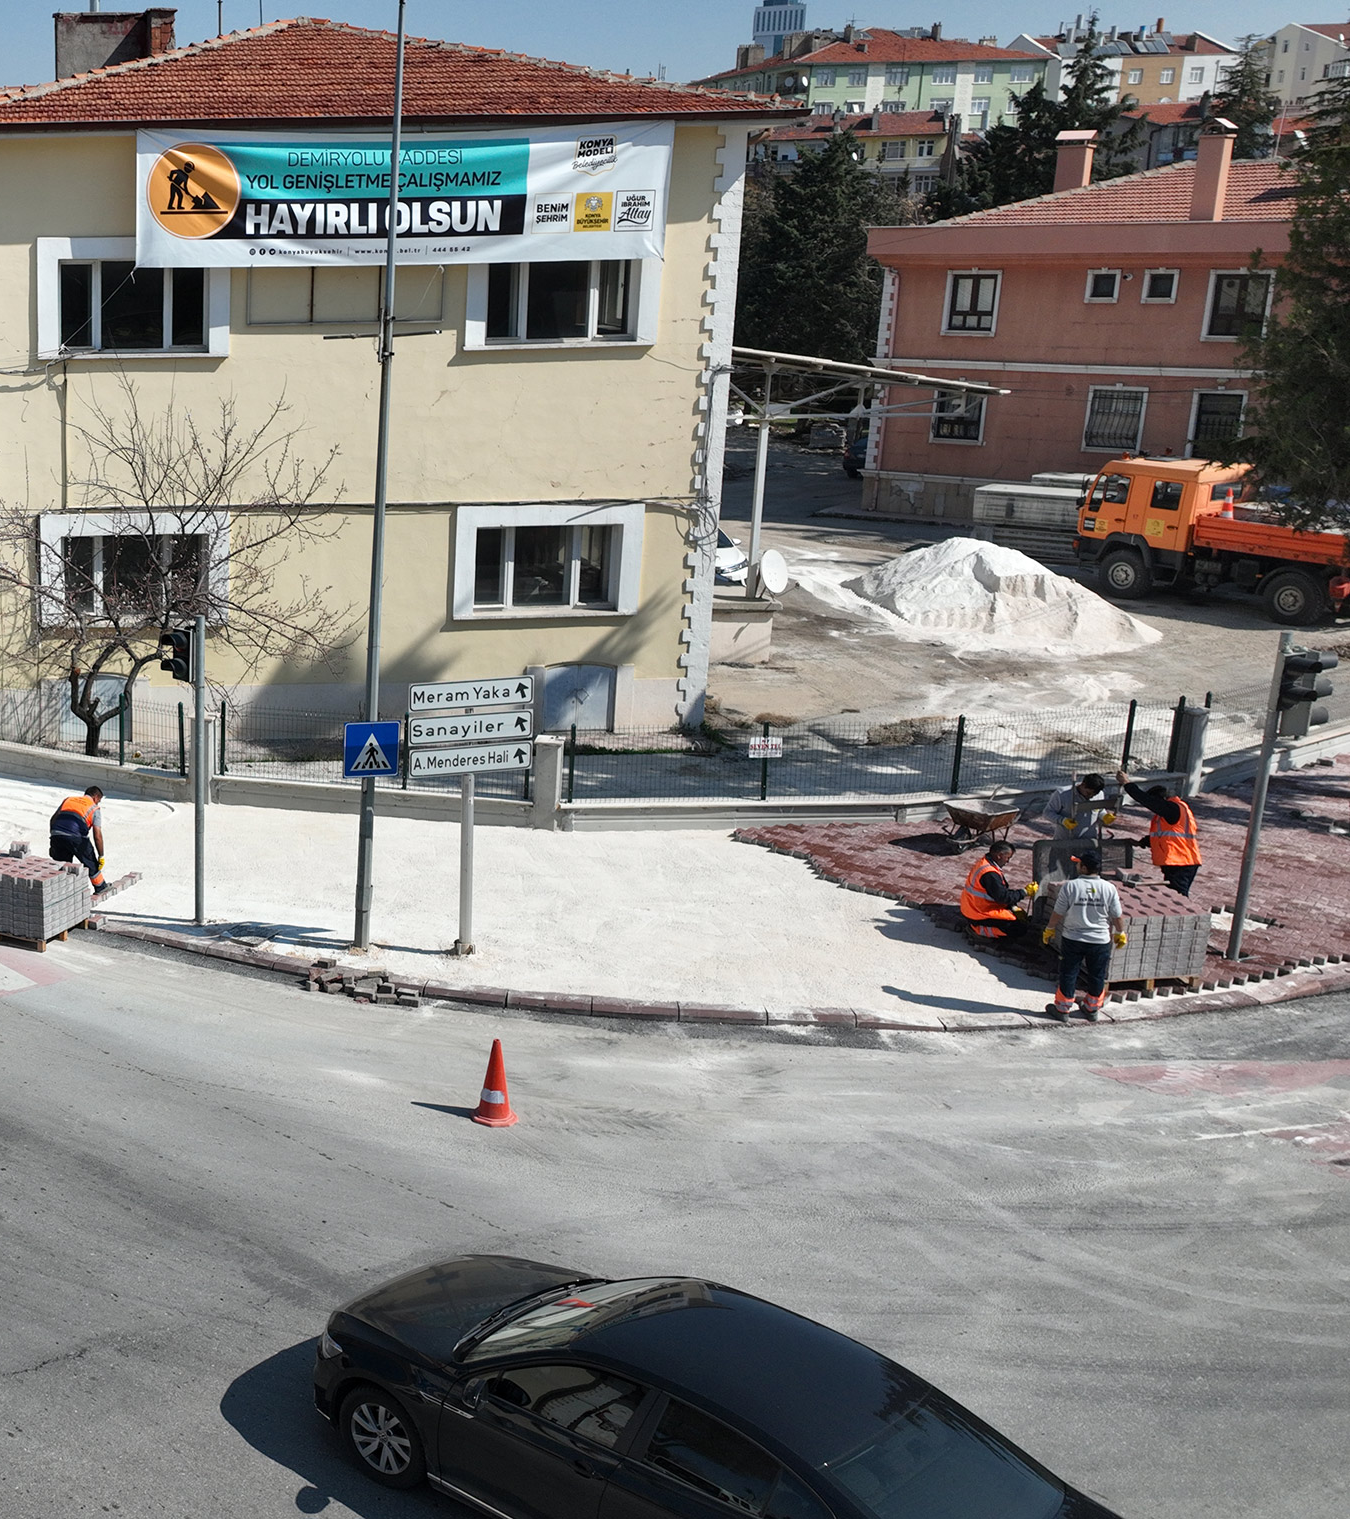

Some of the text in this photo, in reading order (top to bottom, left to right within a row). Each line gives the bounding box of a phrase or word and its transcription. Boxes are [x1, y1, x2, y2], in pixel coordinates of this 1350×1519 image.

[577, 146, 614, 158] MODELİ
[579, 138, 614, 150] KONYA
[287, 149, 385, 167] DEMİRYOLU
[246, 171, 502, 193] YOL GENİŞLETME ÇALIŞMAMIZ
[626, 194, 646, 202] UĞUR
[536, 203, 569, 213] BENİM
[617, 207, 652, 224] Altay
[245, 200, 502, 235] HAYIRLI OLSUN
[536, 213, 568, 224] ŞEHRİM
[413, 686, 510, 704] Meram Yaka
[412, 720, 504, 738] Sanayiler
[413, 750, 509, 770] A.Menderes Hali
